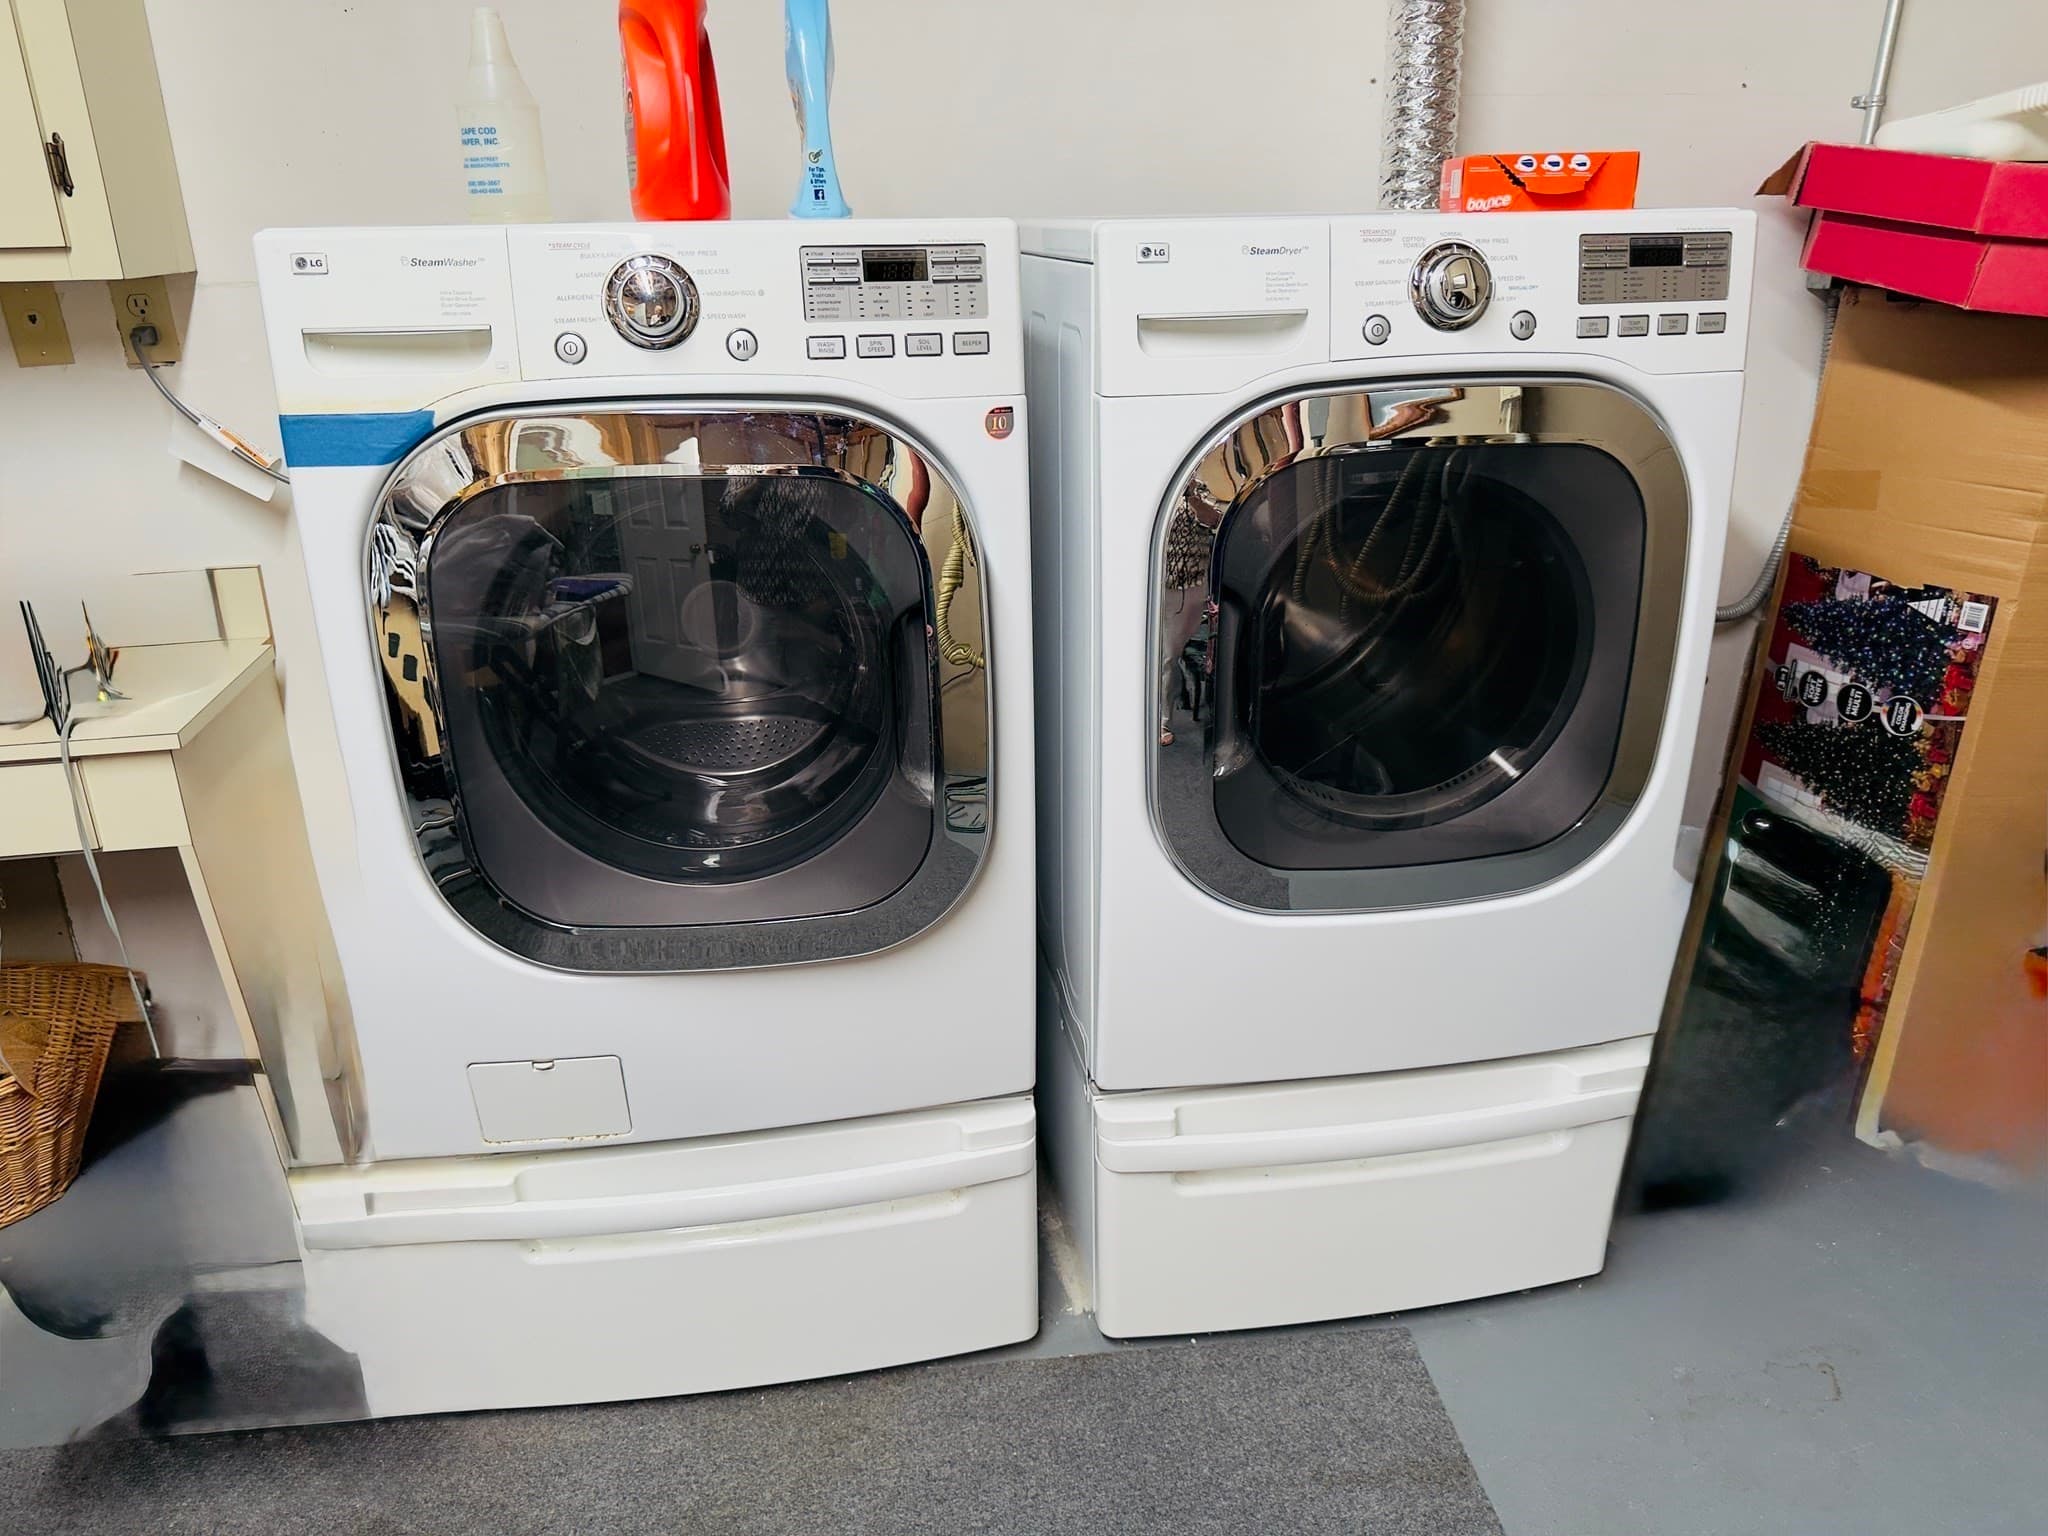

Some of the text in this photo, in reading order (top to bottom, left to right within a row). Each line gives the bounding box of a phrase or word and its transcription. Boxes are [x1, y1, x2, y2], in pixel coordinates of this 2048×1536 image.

[478, 127, 496, 135] COD
[1466, 194, 1512, 212] bounce
[310, 260, 322, 268] LG
[992, 415, 1006, 429] 10
[1808, 679, 1817, 698] SOFT
[1813, 678, 1824, 702] WHITE
[1850, 690, 1863, 716] MULTI
